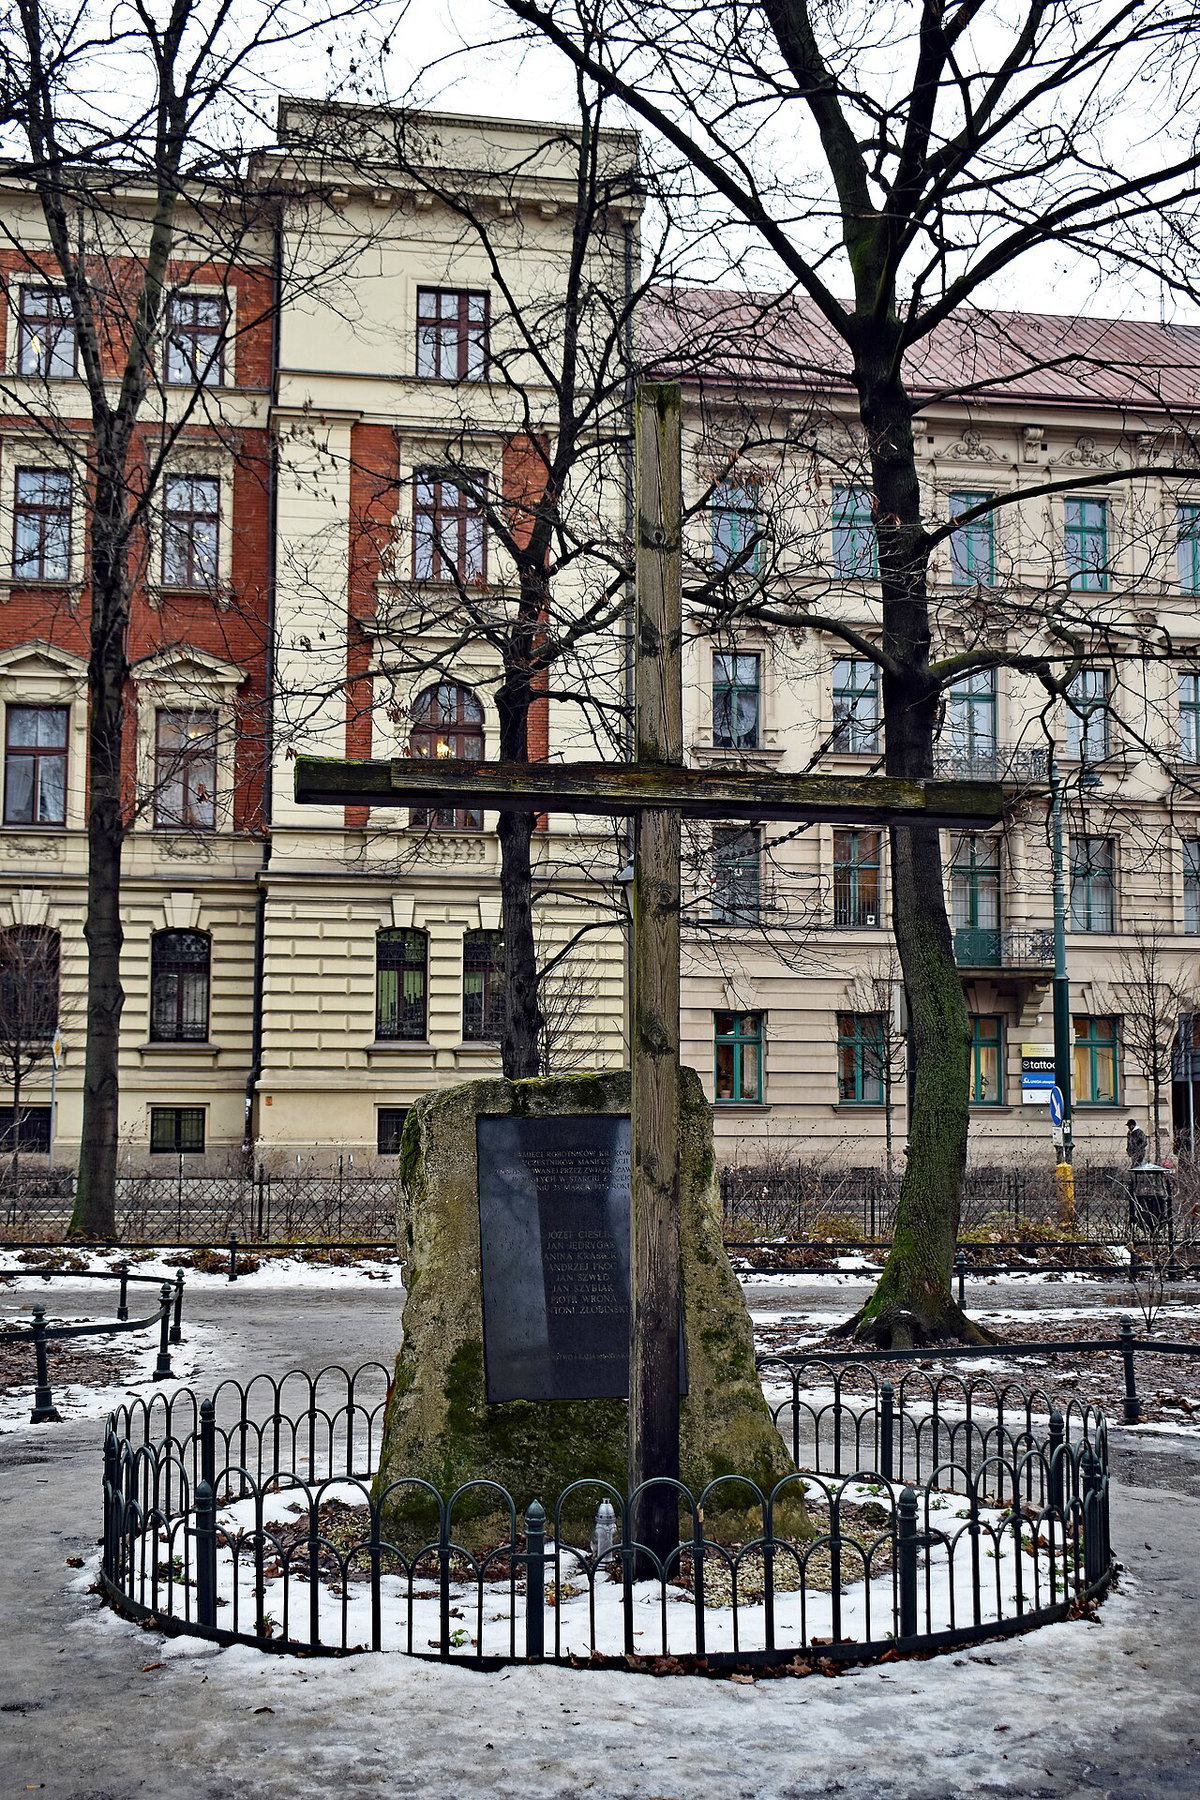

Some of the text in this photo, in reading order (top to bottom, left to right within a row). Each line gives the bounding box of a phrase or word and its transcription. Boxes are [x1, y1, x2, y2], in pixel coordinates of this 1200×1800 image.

[546, 1149, 595, 1157] ROBOTNIKÓW
[547, 1229, 573, 1240] JÓZEF
[546, 1241, 564, 1250] JAN
[547, 1262, 589, 1272] ANDRZEJ
[556, 1273, 574, 1282] JAN
[553, 1283, 614, 1293] JAN SZYBIAK
[551, 1294, 617, 1304] PIOTR WRONA
